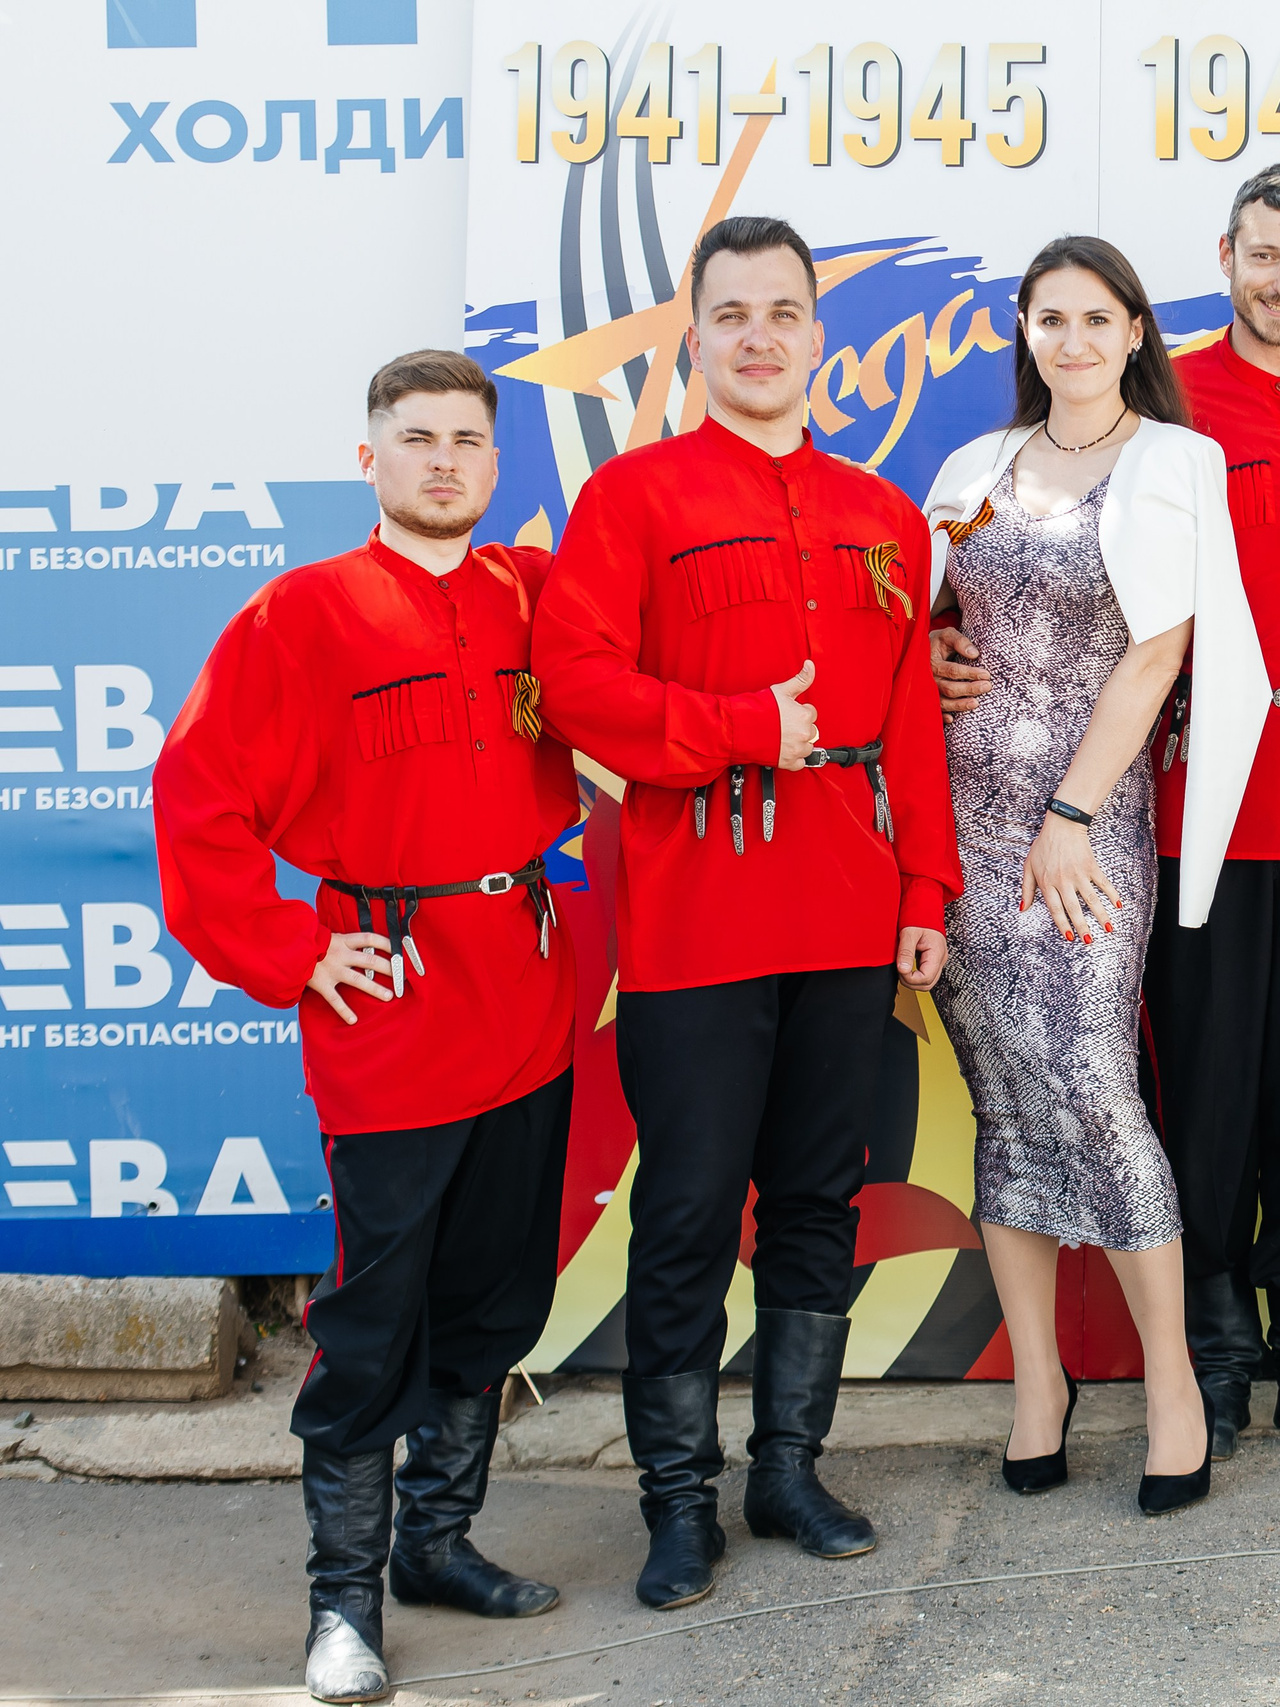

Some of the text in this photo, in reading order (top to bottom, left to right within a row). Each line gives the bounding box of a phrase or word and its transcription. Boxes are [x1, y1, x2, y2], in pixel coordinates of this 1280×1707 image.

[106, 97, 465, 174] ХОЛДИ
[29, 543, 286, 571] БЕЗОПАСНОСТИ
[44, 1020, 299, 1048] БЕЗОПАСНОСТИ
